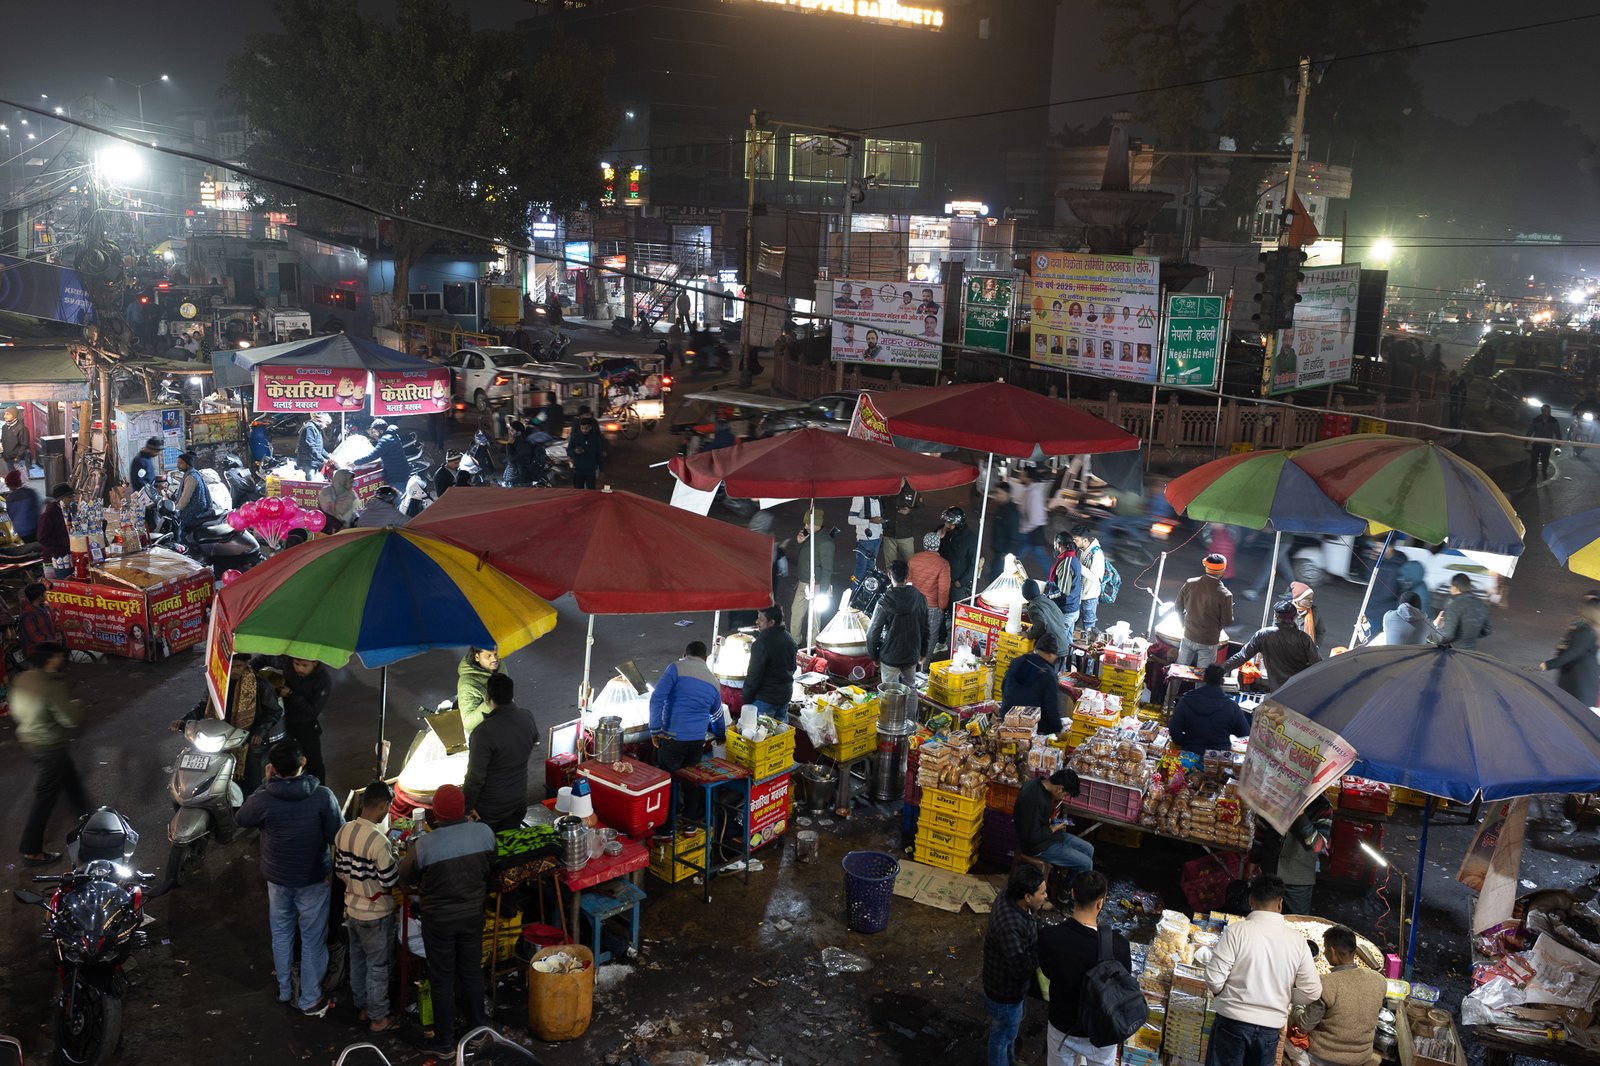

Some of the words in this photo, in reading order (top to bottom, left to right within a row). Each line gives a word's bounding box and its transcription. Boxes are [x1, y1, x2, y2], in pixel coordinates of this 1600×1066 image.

[978, 314, 994, 327] चौक
[1171, 326, 1192, 341] नेपाली
[1196, 325, 1216, 342] हवेली
[1168, 348, 1191, 359] Nepali
[1192, 348, 1214, 359] Haveli
[265, 380, 336, 399] केसरिया
[381, 384, 432, 402] केसरिया
[272, 401, 292, 409] मलाई
[386, 404, 402, 412] मलाई
[45, 591, 94, 608] लखनऊ
[96, 595, 142, 618] भेलपूरी
[152, 595, 182, 616] लखनऊ
[186, 582, 212, 605] भेलपूरी
[968, 612, 982, 622] मलाई
[854, 726, 868, 736] Amul
[768, 741, 784, 750] अमूल
[768, 760, 784, 770] Amul
[936, 816, 956, 827] Amul
[932, 832, 952, 844] Amul
